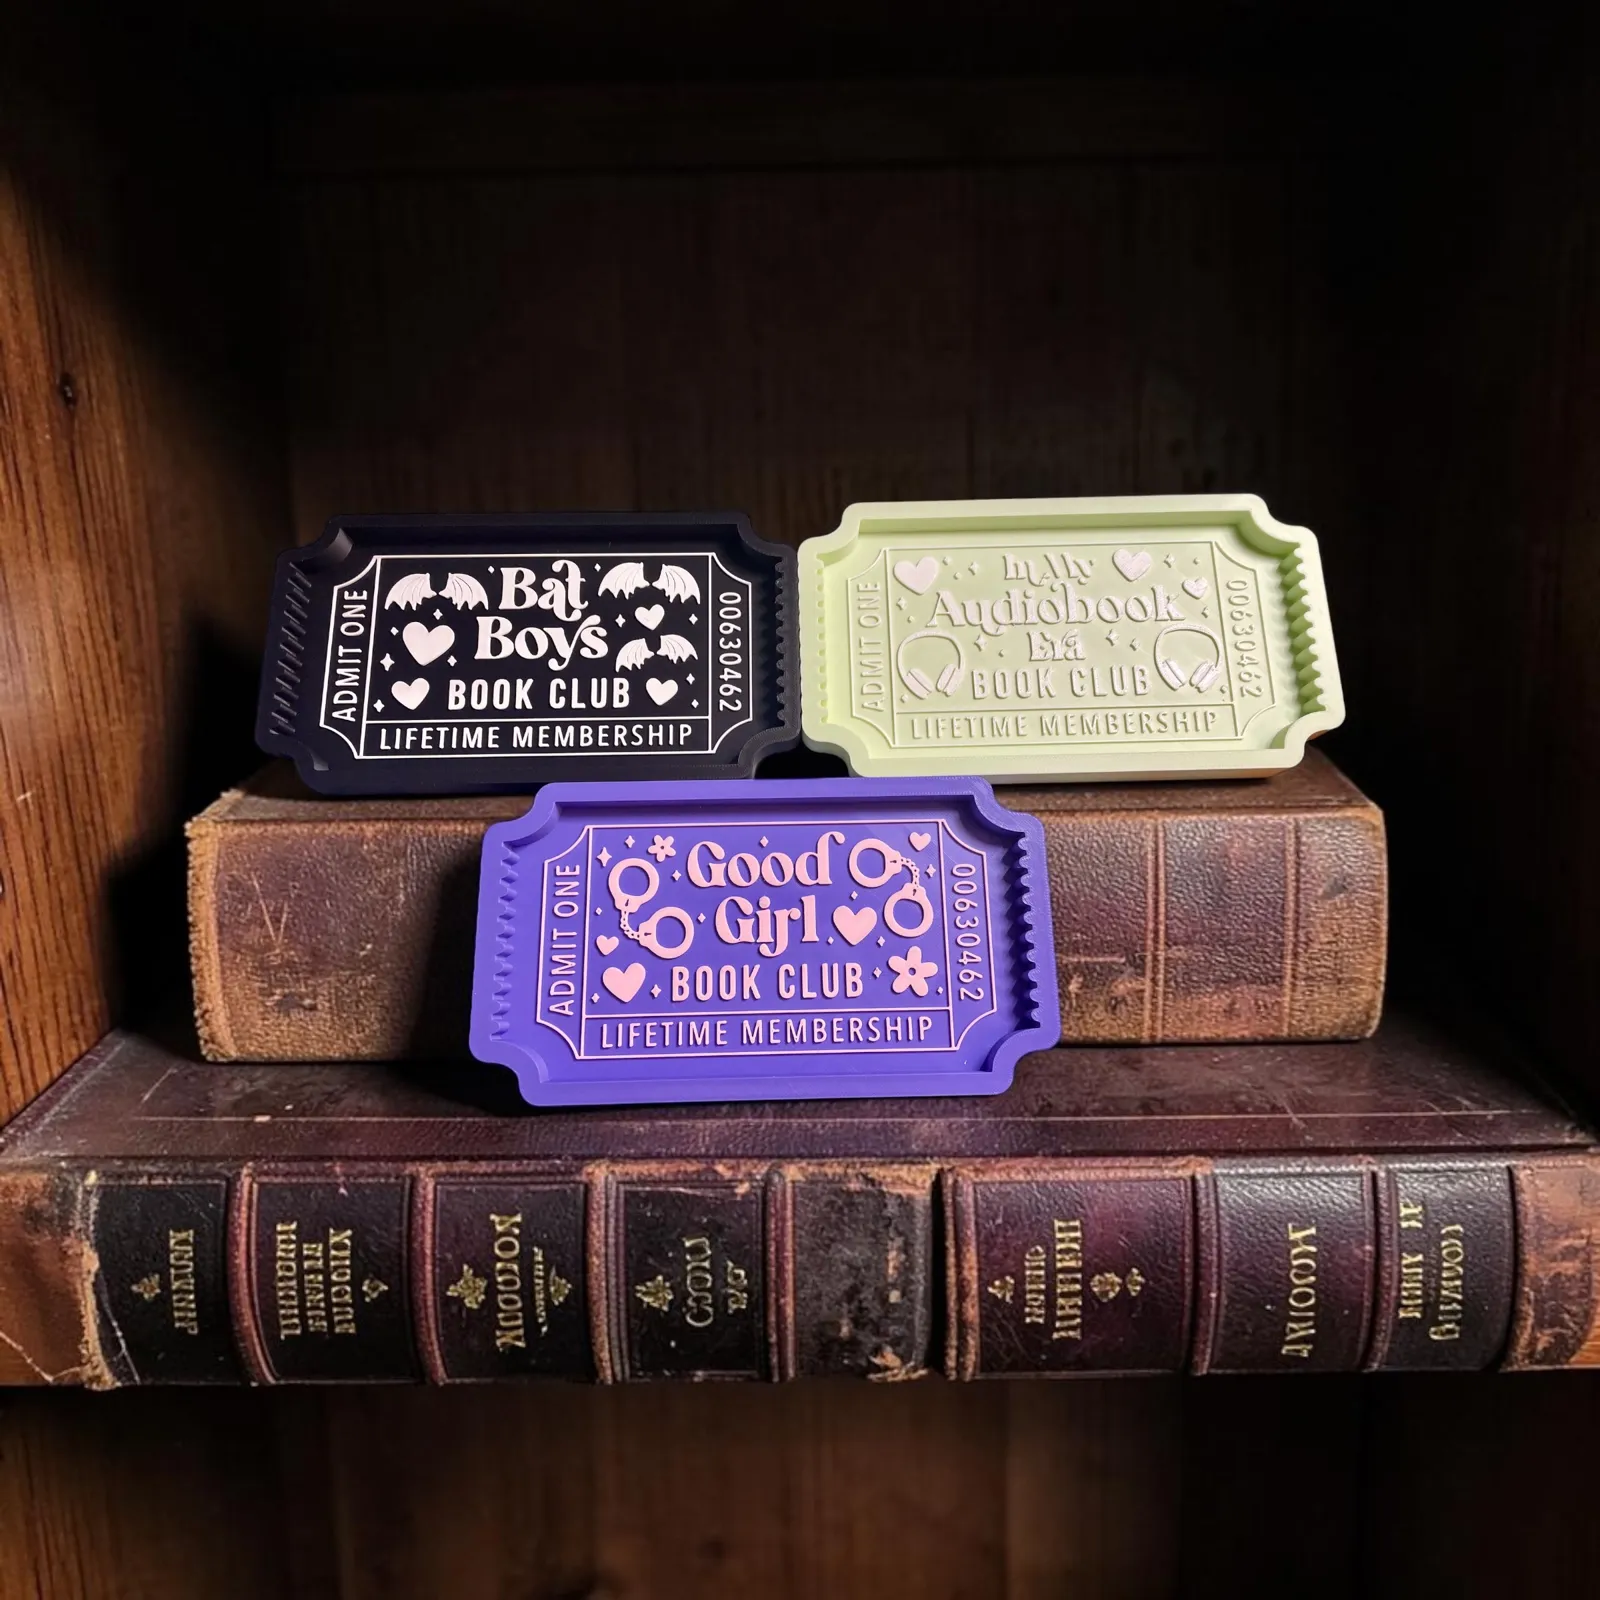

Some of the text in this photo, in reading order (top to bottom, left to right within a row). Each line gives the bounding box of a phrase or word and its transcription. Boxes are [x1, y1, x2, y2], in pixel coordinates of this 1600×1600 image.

[498, 560, 588, 622] Bat
[925, 580, 1187, 636] Audiobook
[332, 589, 367, 722] ADMIT ONE
[474, 614, 608, 671] Boys
[718, 592, 742, 712] 00630462
[858, 581, 885, 712] ADMIT ONE
[447, 678, 630, 710] BOOK CLUB
[972, 665, 1150, 699] BOOK CLUB
[379, 724, 693, 750] LIFETIME MEMBERSHIP
[912, 711, 1218, 740] LIFETIME MEMBERSHIP
[687, 831, 844, 888] Good
[549, 863, 580, 1016] ADMIT ONE
[715, 895, 819, 956] Girl
[951, 863, 983, 1001] 00630462
[671, 963, 864, 1002] BOOK CLUB
[601, 1017, 933, 1049] LIFETIME MEMBERSHIP
